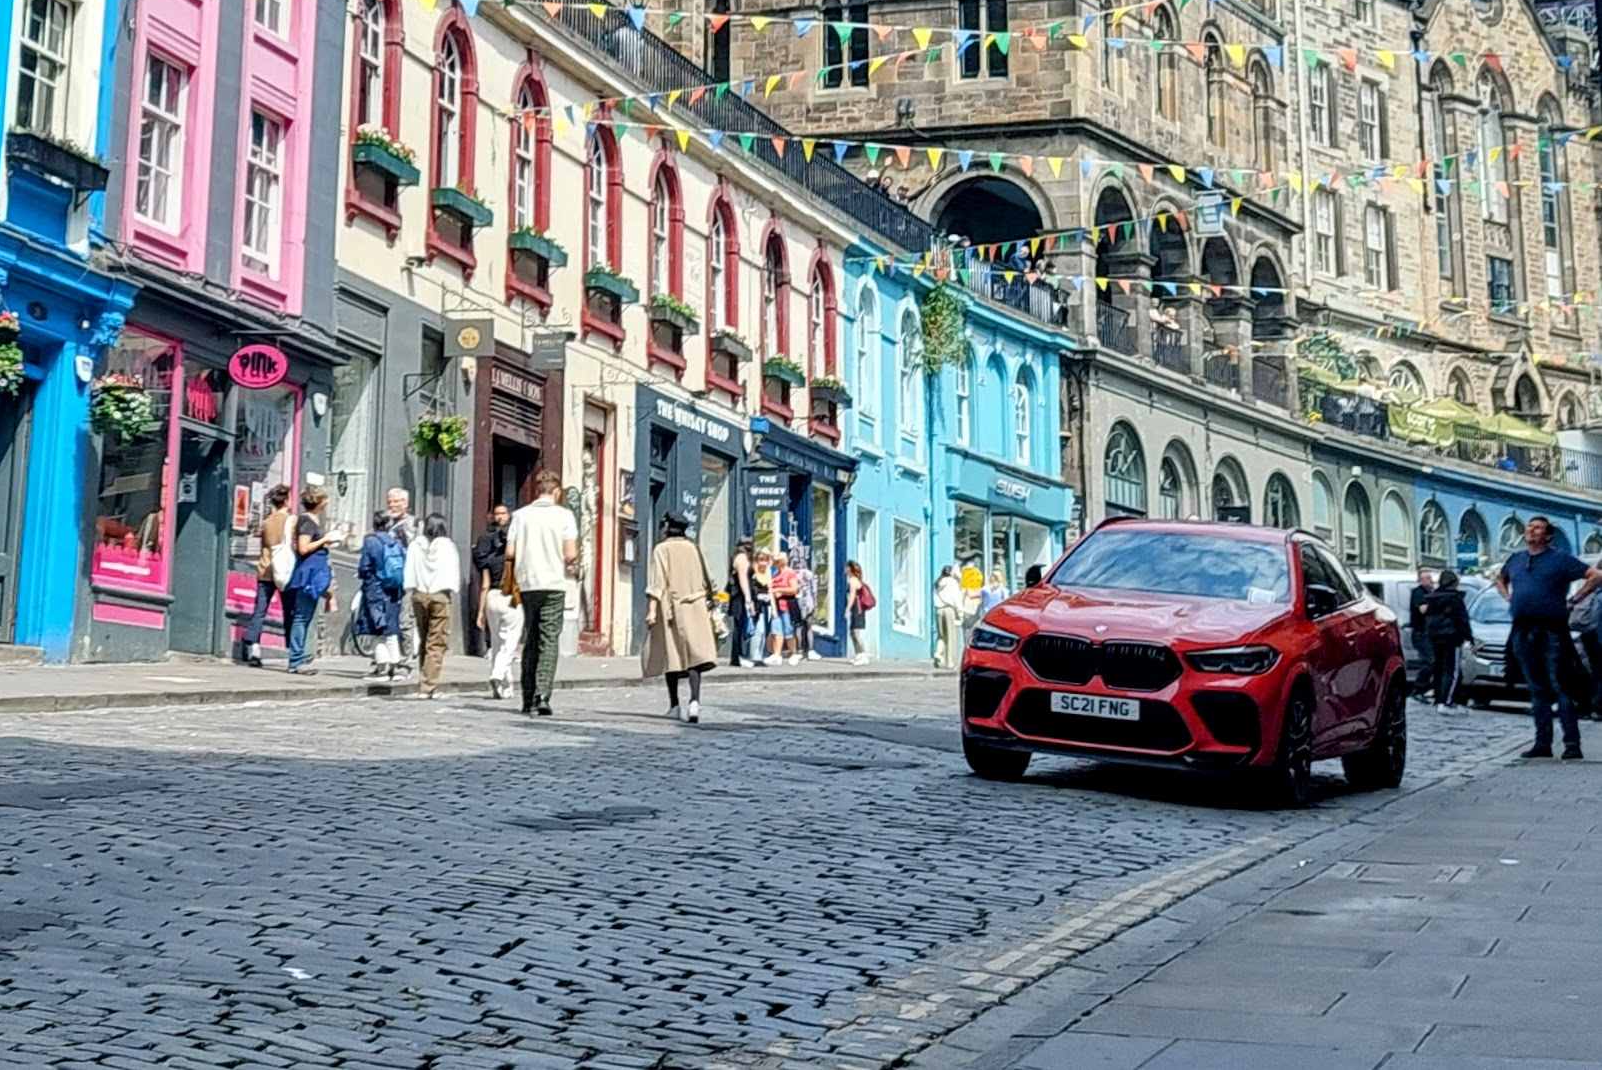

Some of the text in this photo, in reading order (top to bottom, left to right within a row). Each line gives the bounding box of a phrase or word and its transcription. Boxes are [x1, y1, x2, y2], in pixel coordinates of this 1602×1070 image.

[656, 399, 730, 443] THE WHISKY SHOP
[758, 475, 777, 483] THE
[750, 486, 786, 495] WHISKY
[756, 499, 781, 507] SHOP
[1061, 695, 1130, 716] SC21 FNG
